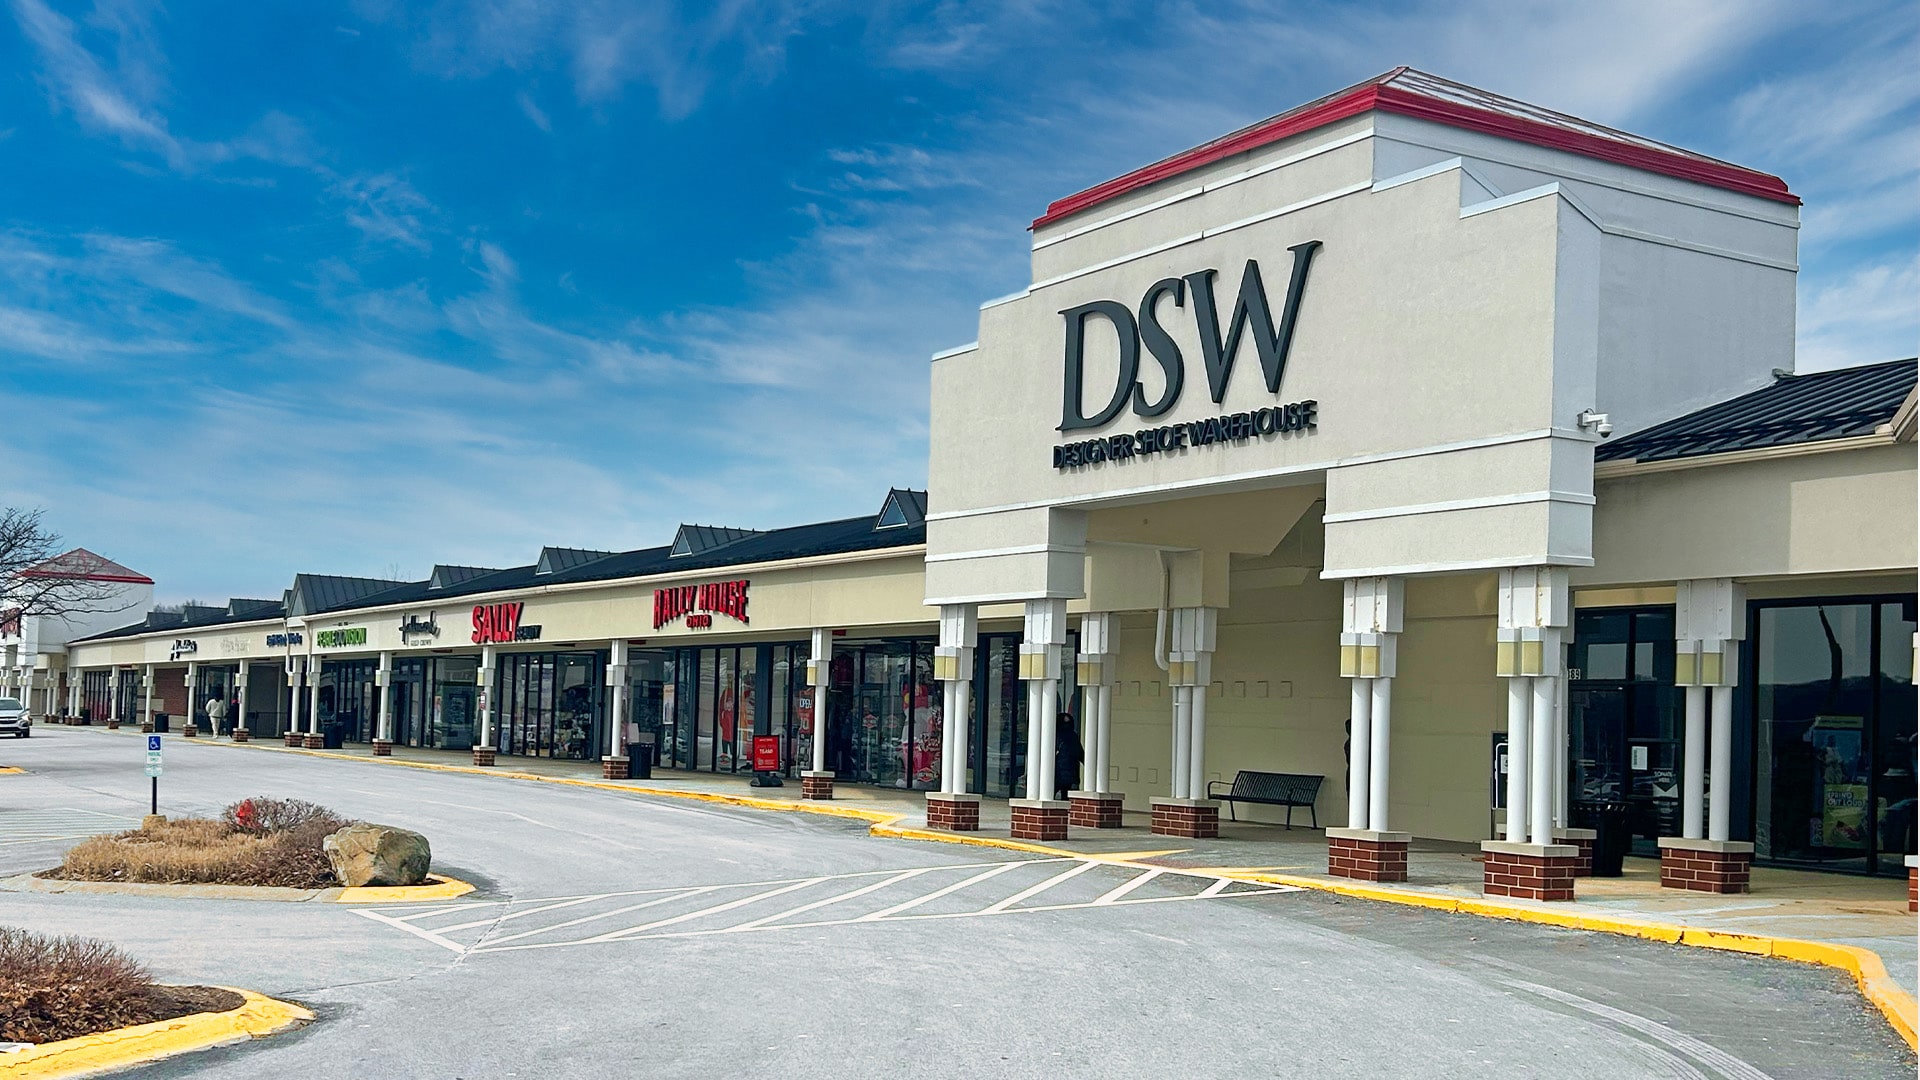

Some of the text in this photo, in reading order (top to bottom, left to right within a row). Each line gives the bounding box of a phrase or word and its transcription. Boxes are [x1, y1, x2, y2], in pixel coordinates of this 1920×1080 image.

[1055, 240, 1323, 431] DSW
[1053, 399, 1318, 468] DESIGNER SHOE WAREHOUSE
[472, 602, 524, 644] SALLY
[653, 580, 750, 630] RALLY HOUSE
[686, 614, 712, 628] OHIO
[1843, 799, 1863, 807] LOUD
